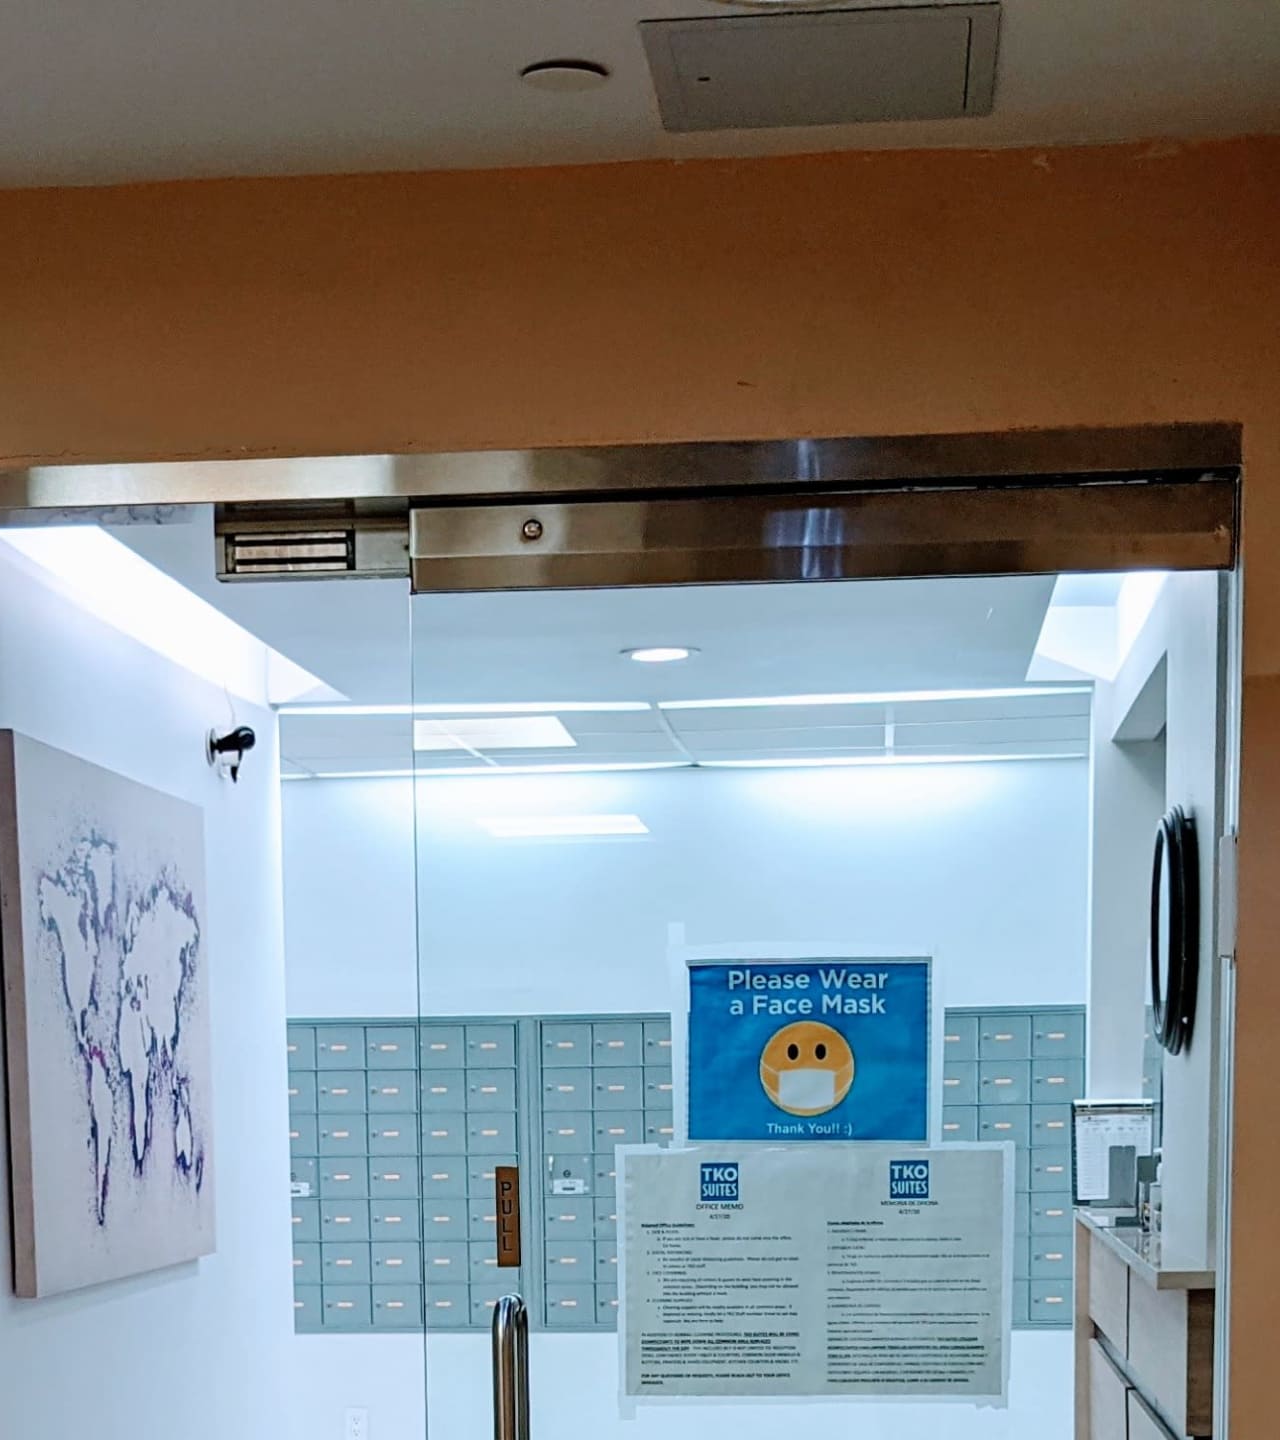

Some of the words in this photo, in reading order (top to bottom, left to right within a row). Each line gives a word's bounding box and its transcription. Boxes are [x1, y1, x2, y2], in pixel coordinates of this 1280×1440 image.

[728, 968, 811, 990] Please
[818, 968, 889, 990] Wear
[729, 998, 744, 1015] a
[752, 994, 814, 1016] Face
[821, 993, 887, 1015] Mask
[766, 1122, 805, 1135] Thank
[807, 1122, 840, 1135] You!!
[702, 1167, 738, 1182] TKO
[892, 1164, 928, 1180] TKO
[702, 1183, 737, 1197] SUITES
[891, 1180, 928, 1195] SUITES
[500, 1182, 512, 1251] PULL
